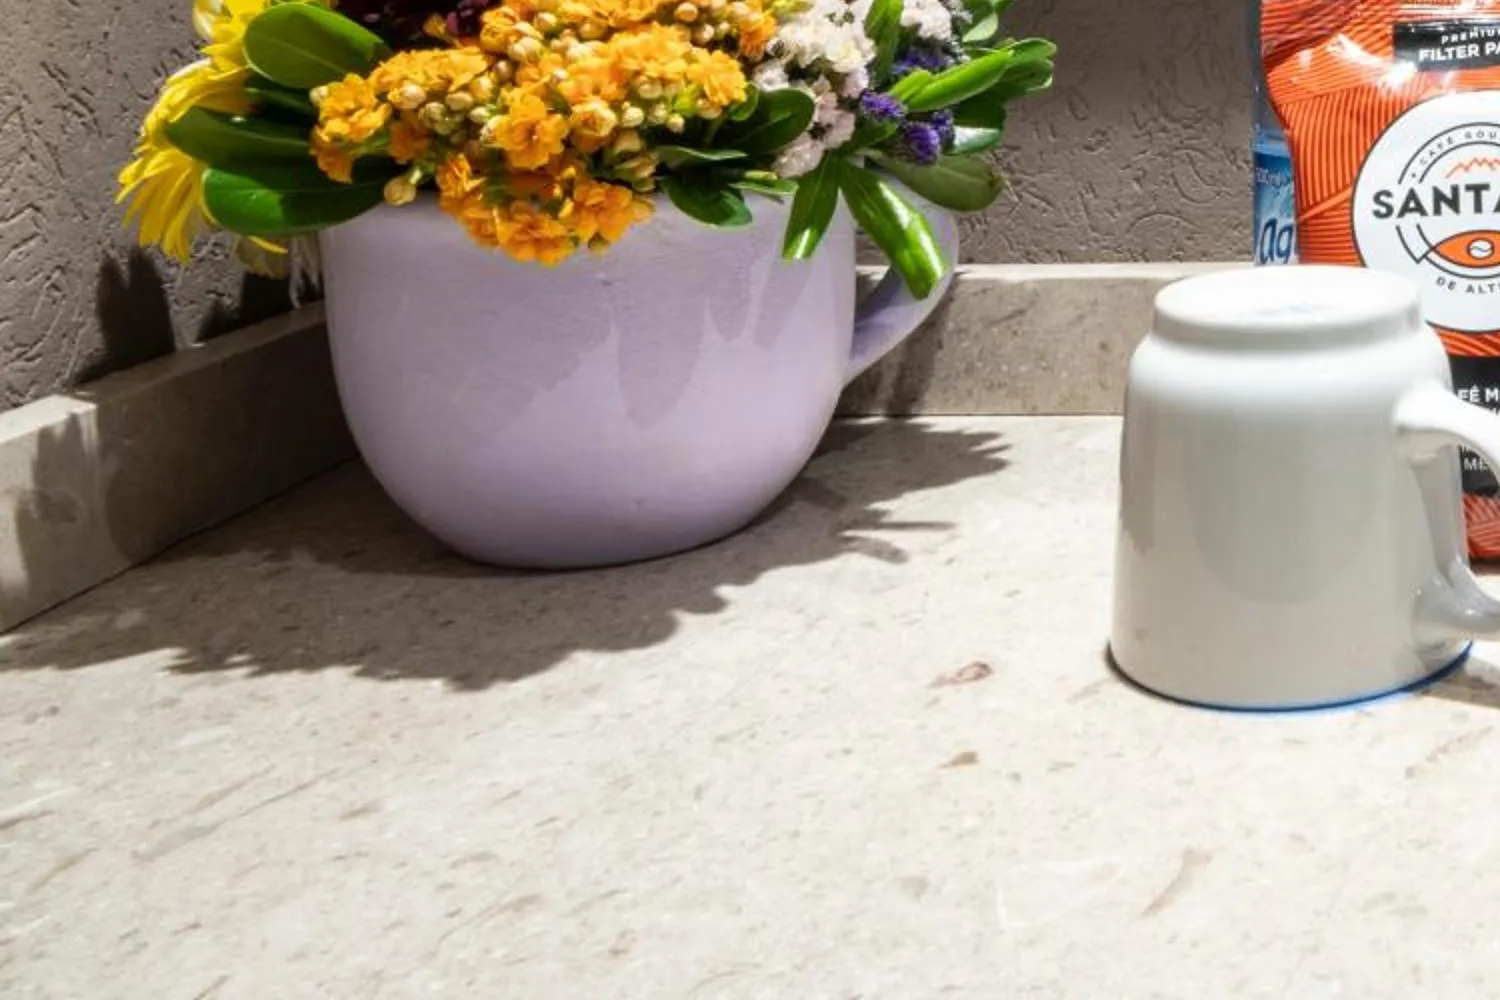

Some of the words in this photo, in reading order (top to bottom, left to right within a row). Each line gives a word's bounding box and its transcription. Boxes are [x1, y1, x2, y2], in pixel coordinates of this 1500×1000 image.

[1419, 43, 1480, 61] FILTER
[1436, 275, 1457, 291] DE
[1458, 385, 1480, 402] FÉ
